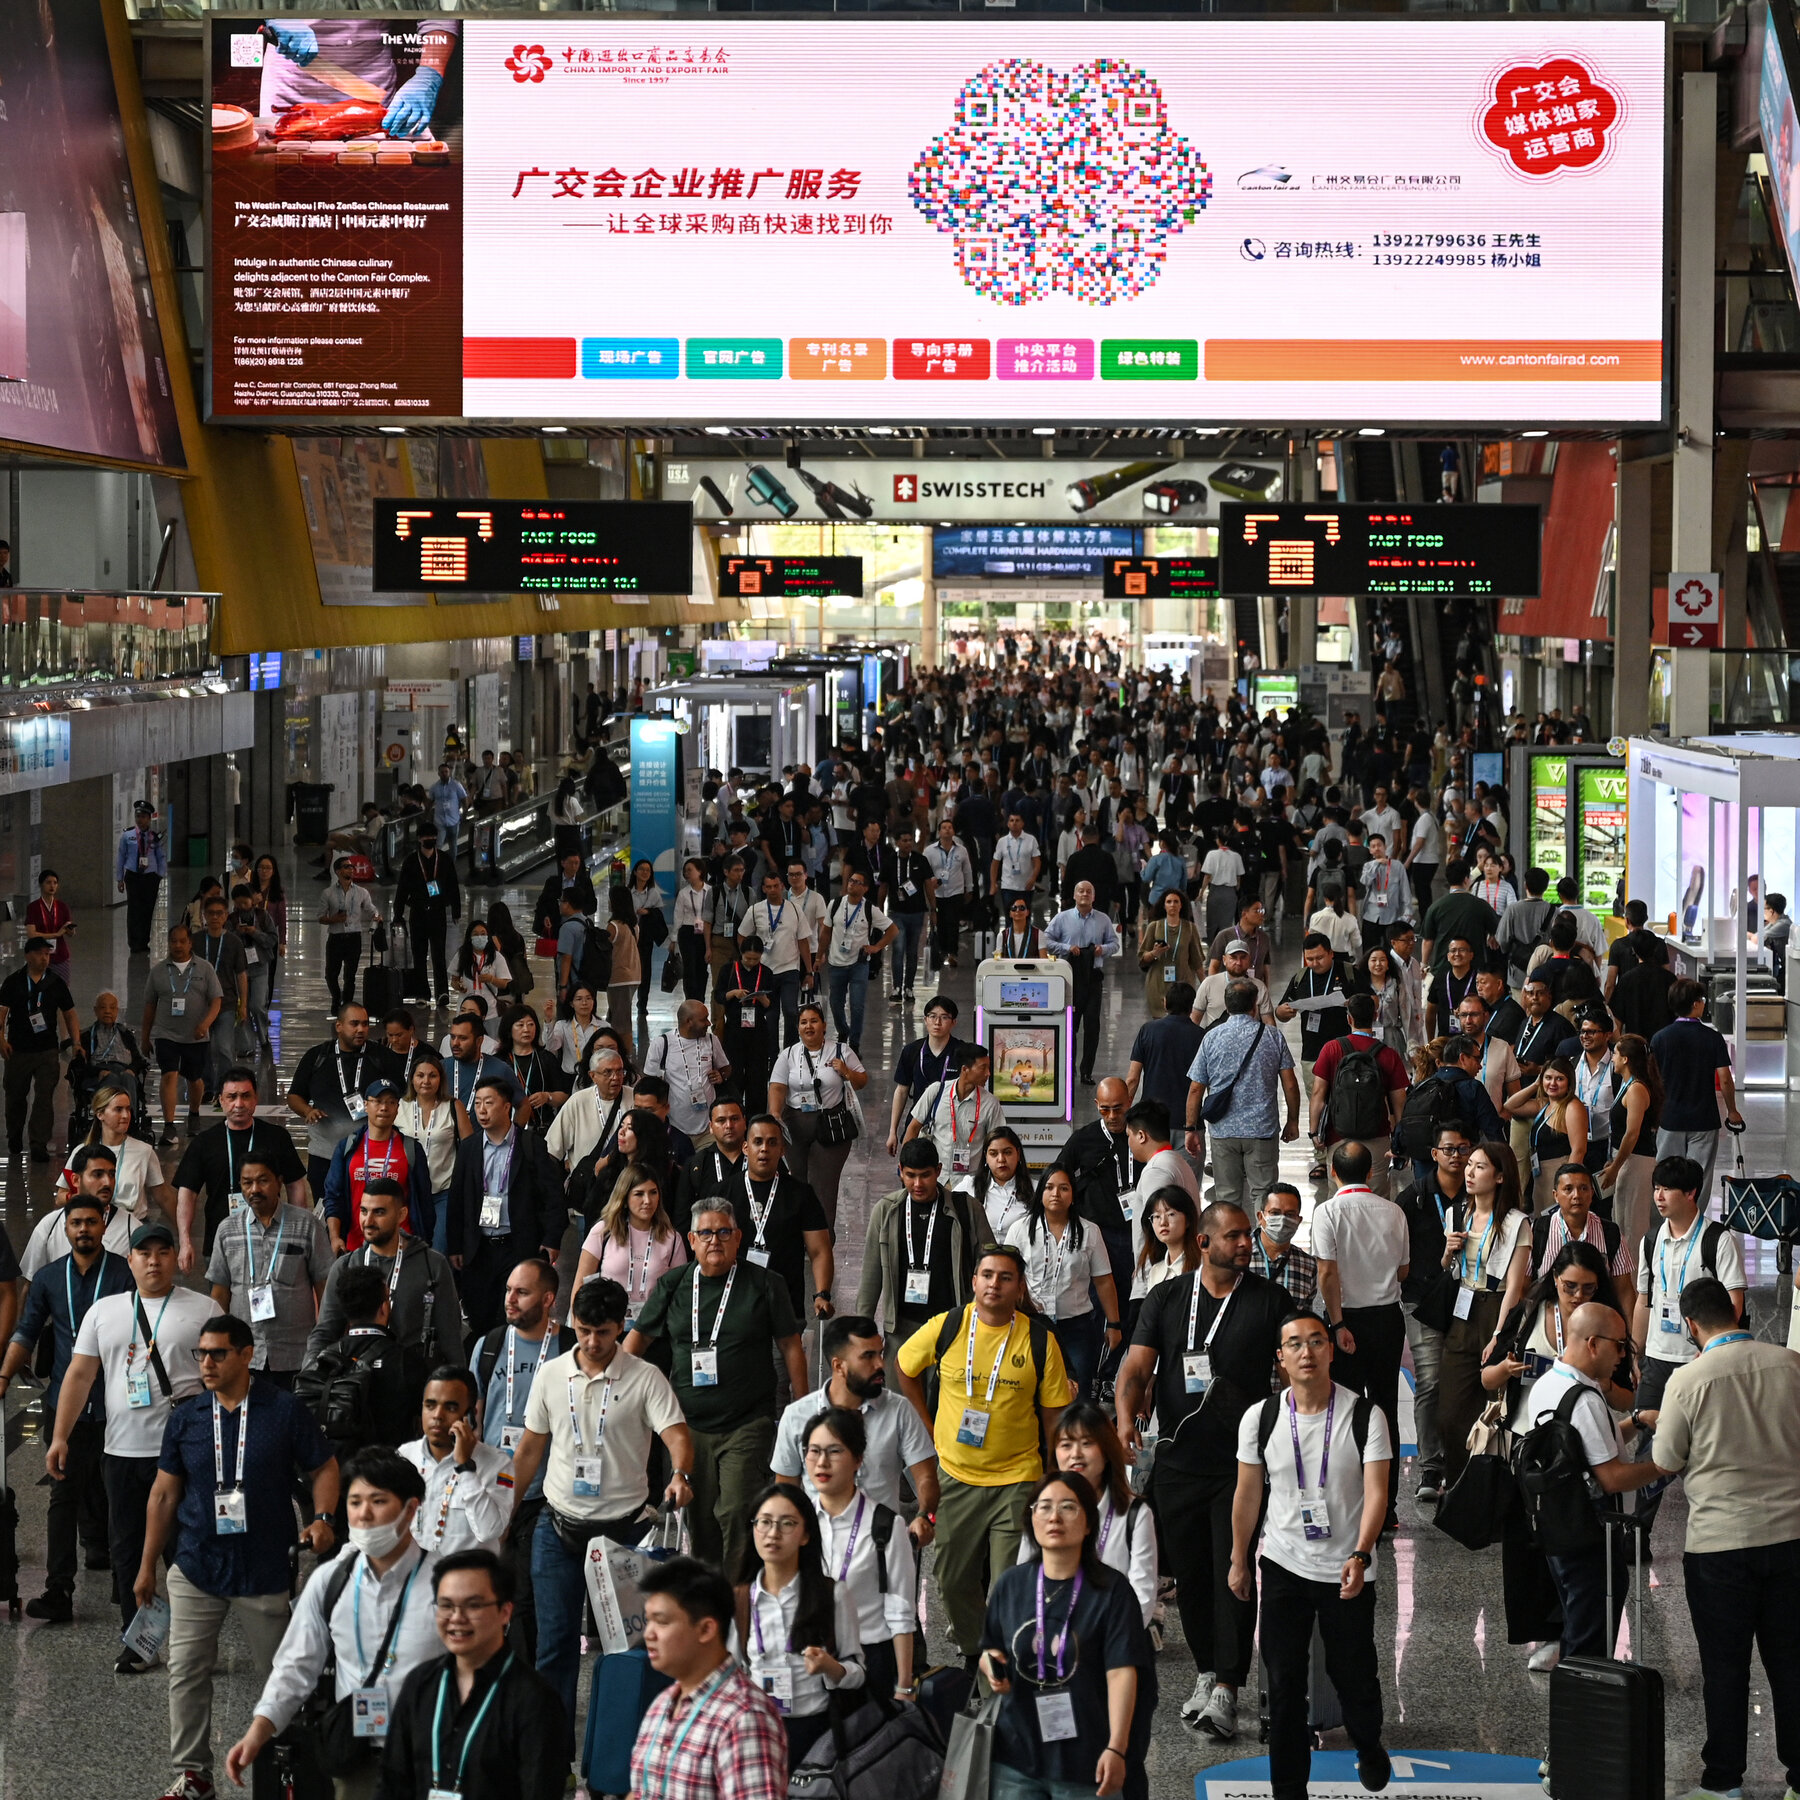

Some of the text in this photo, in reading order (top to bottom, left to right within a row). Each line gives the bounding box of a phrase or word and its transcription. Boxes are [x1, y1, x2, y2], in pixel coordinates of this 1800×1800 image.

[403, 33, 447, 44] WESTIN
[1510, 75, 1582, 108] 广交会
[1504, 98, 1601, 137] 媒体独家
[1523, 127, 1596, 160] 运营商
[511, 166, 863, 200] 广交会企业推广服务
[1372, 234, 1542, 247] 13922799636 王先生
[234, 258, 393, 268] Indulge in authentic Chinese culinary
[1372, 252, 1542, 268] 13922249985 杨小姐
[234, 273, 430, 283] delights adjacent to the Canton Fair Complex.
[234, 336, 362, 345] For more information please contact
[806, 343, 868, 356] 专刊名录
[911, 343, 973, 357] 导向手册
[1014, 343, 1077, 357] 中央平台
[599, 350, 662, 364] 现场广告
[702, 350, 765, 364] 官网广告
[1117, 351, 1181, 366] 绿色特装
[1460, 354, 1620, 366] www.cantonfairad.com
[822, 359, 852, 372] 广告
[926, 359, 957, 373] 广告
[1014, 359, 1077, 373] 推介活动
[921, 482, 1045, 498] SWISSTECH
[942, 547, 988, 556] COMPLETE
[989, 547, 1035, 556] FURNITURE
[1037, 547, 1084, 556] HARDWARE
